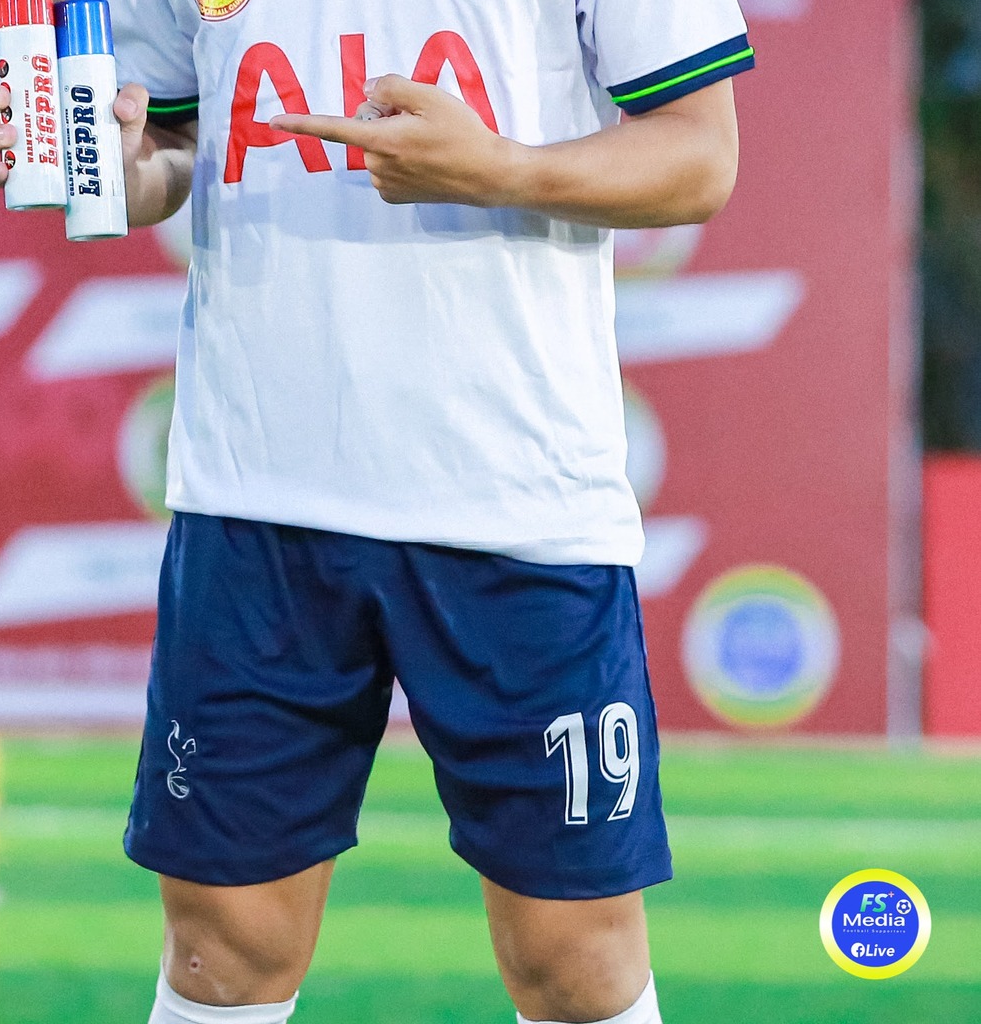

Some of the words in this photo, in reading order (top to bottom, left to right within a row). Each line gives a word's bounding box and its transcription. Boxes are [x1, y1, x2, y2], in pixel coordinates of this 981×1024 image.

[200, 5, 229, 15] OOTBALL
[24, 113, 33, 138] SPRAY
[26, 139, 35, 164] WARM
[543, 702, 640, 825] 19
